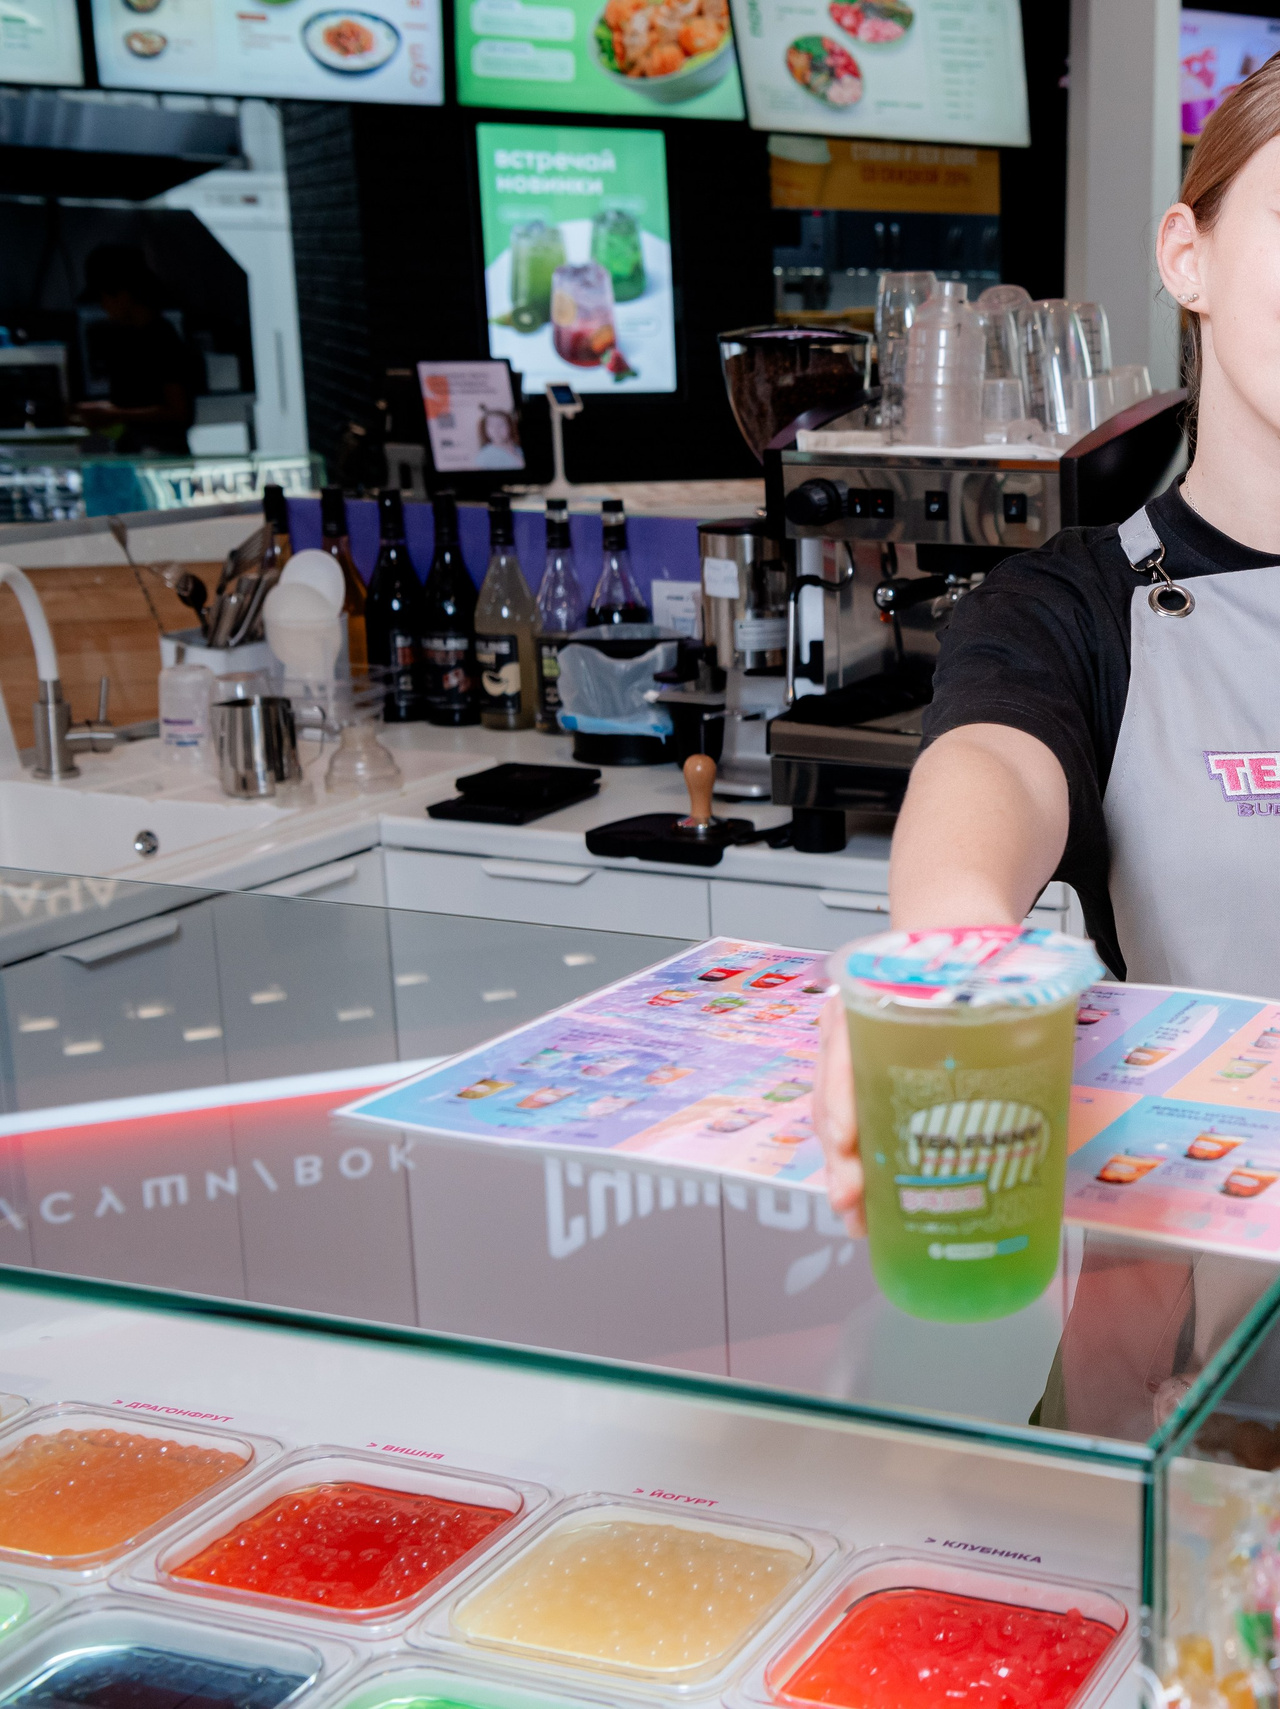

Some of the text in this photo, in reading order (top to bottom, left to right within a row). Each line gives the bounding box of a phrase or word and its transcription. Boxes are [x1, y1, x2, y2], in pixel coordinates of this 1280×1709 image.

[494, 149, 617, 174] встречай
[496, 175, 604, 196] новинки
[124, 1401, 235, 1423] ДРАГОНФРУТ
[381, 1444, 445, 1461] ВИШНЯ
[649, 1488, 719, 1508] ЙОГУРТ
[942, 1540, 1042, 1564] КЛУБНИКА
